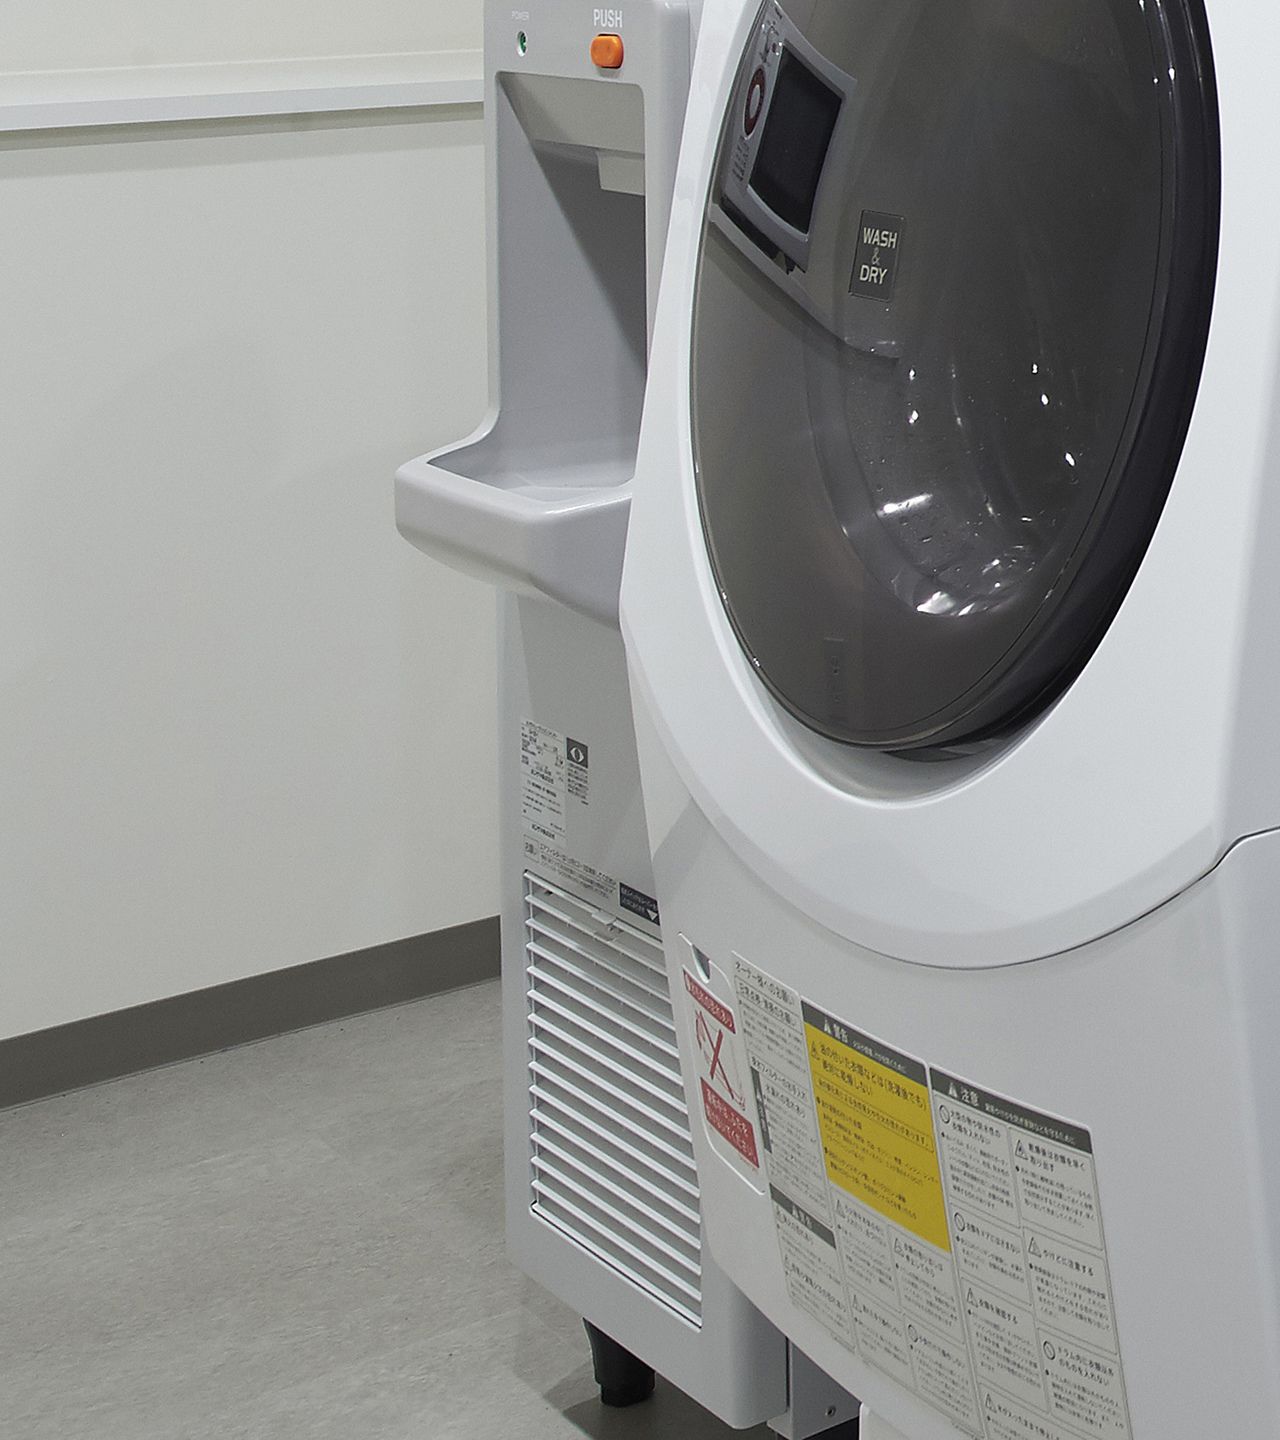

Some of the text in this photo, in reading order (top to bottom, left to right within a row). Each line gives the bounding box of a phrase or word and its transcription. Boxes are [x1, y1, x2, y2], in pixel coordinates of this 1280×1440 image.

[593, 9, 623, 28] PUSH
[863, 227, 897, 248] WASH
[860, 265, 887, 284] DRY
